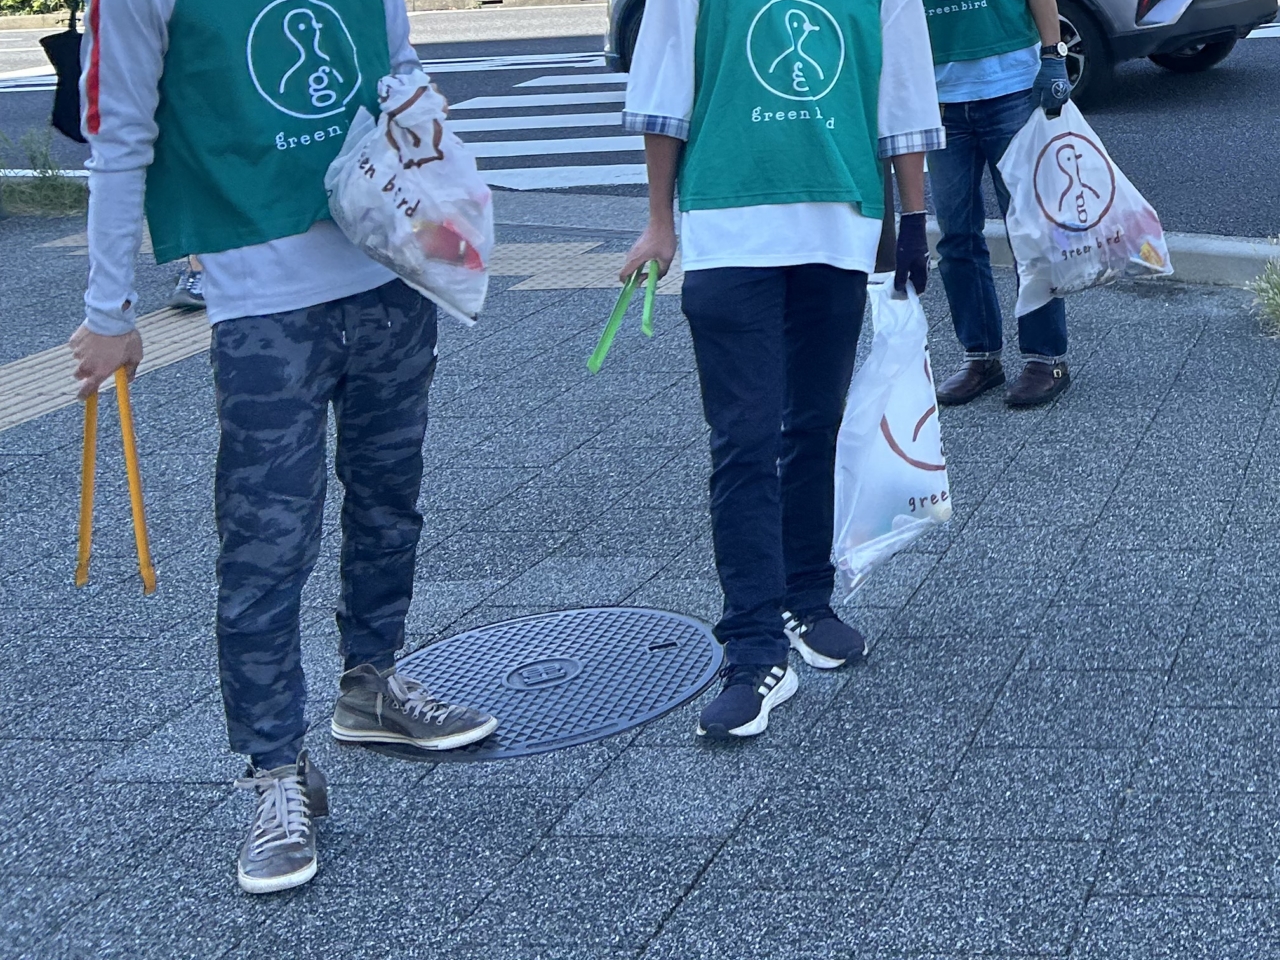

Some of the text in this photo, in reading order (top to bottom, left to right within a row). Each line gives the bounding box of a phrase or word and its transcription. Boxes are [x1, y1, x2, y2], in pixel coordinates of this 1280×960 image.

[924, 4, 960, 17] reen
[751, 105, 811, 123] green
[275, 124, 343, 151] green
[1095, 230, 1121, 249] brd
